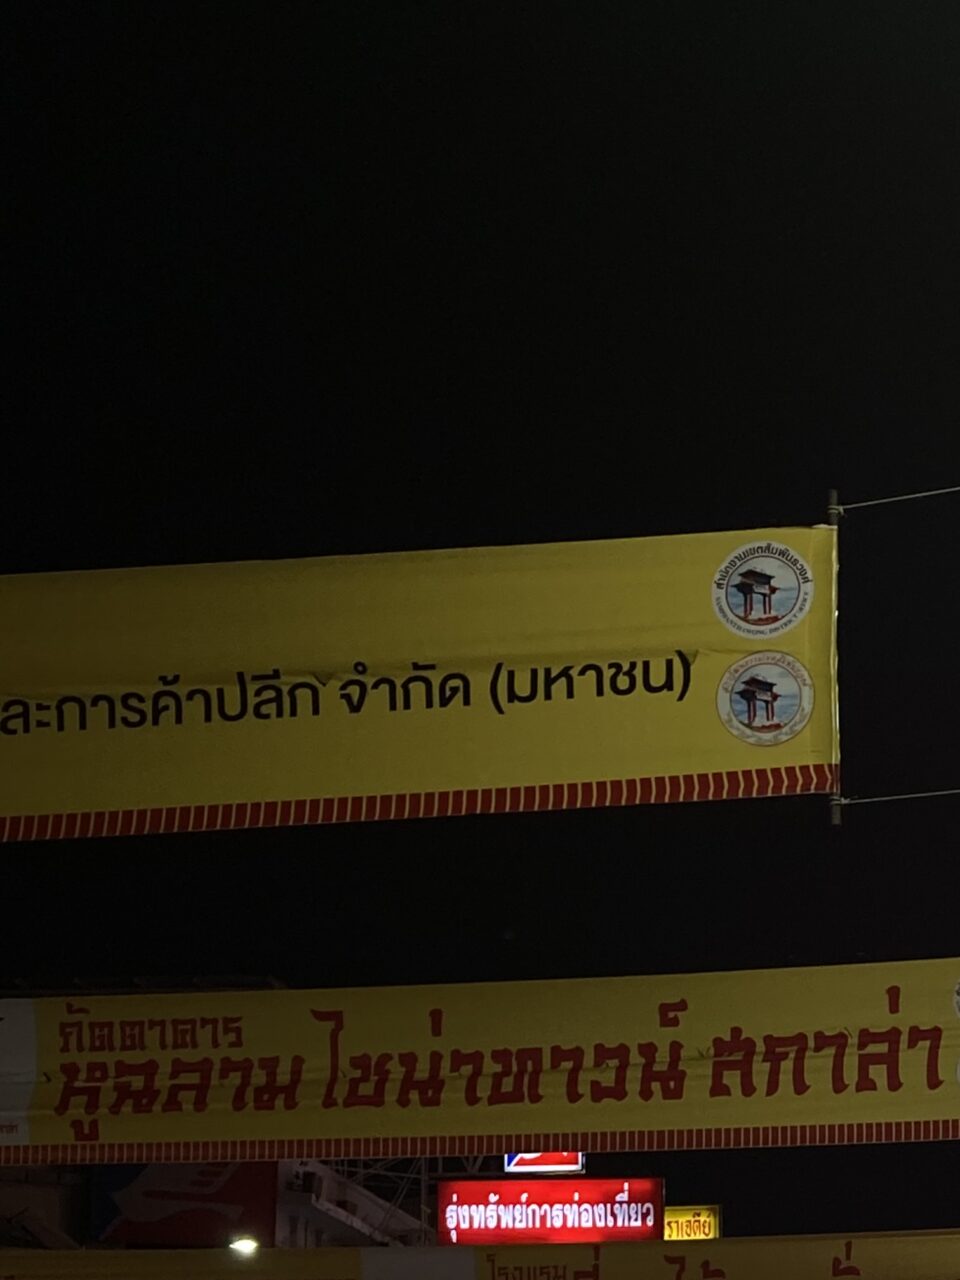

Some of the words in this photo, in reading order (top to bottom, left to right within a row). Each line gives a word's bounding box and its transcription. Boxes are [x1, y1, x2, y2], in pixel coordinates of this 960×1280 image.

[339, 661, 471, 712] จำกัด
[490, 650, 692, 715] (มหาชน)
[710, 985, 944, 1098] สกาล่า
[445, 1182, 655, 1243] รุ่งทรัพย์การท่องเที่ยว
